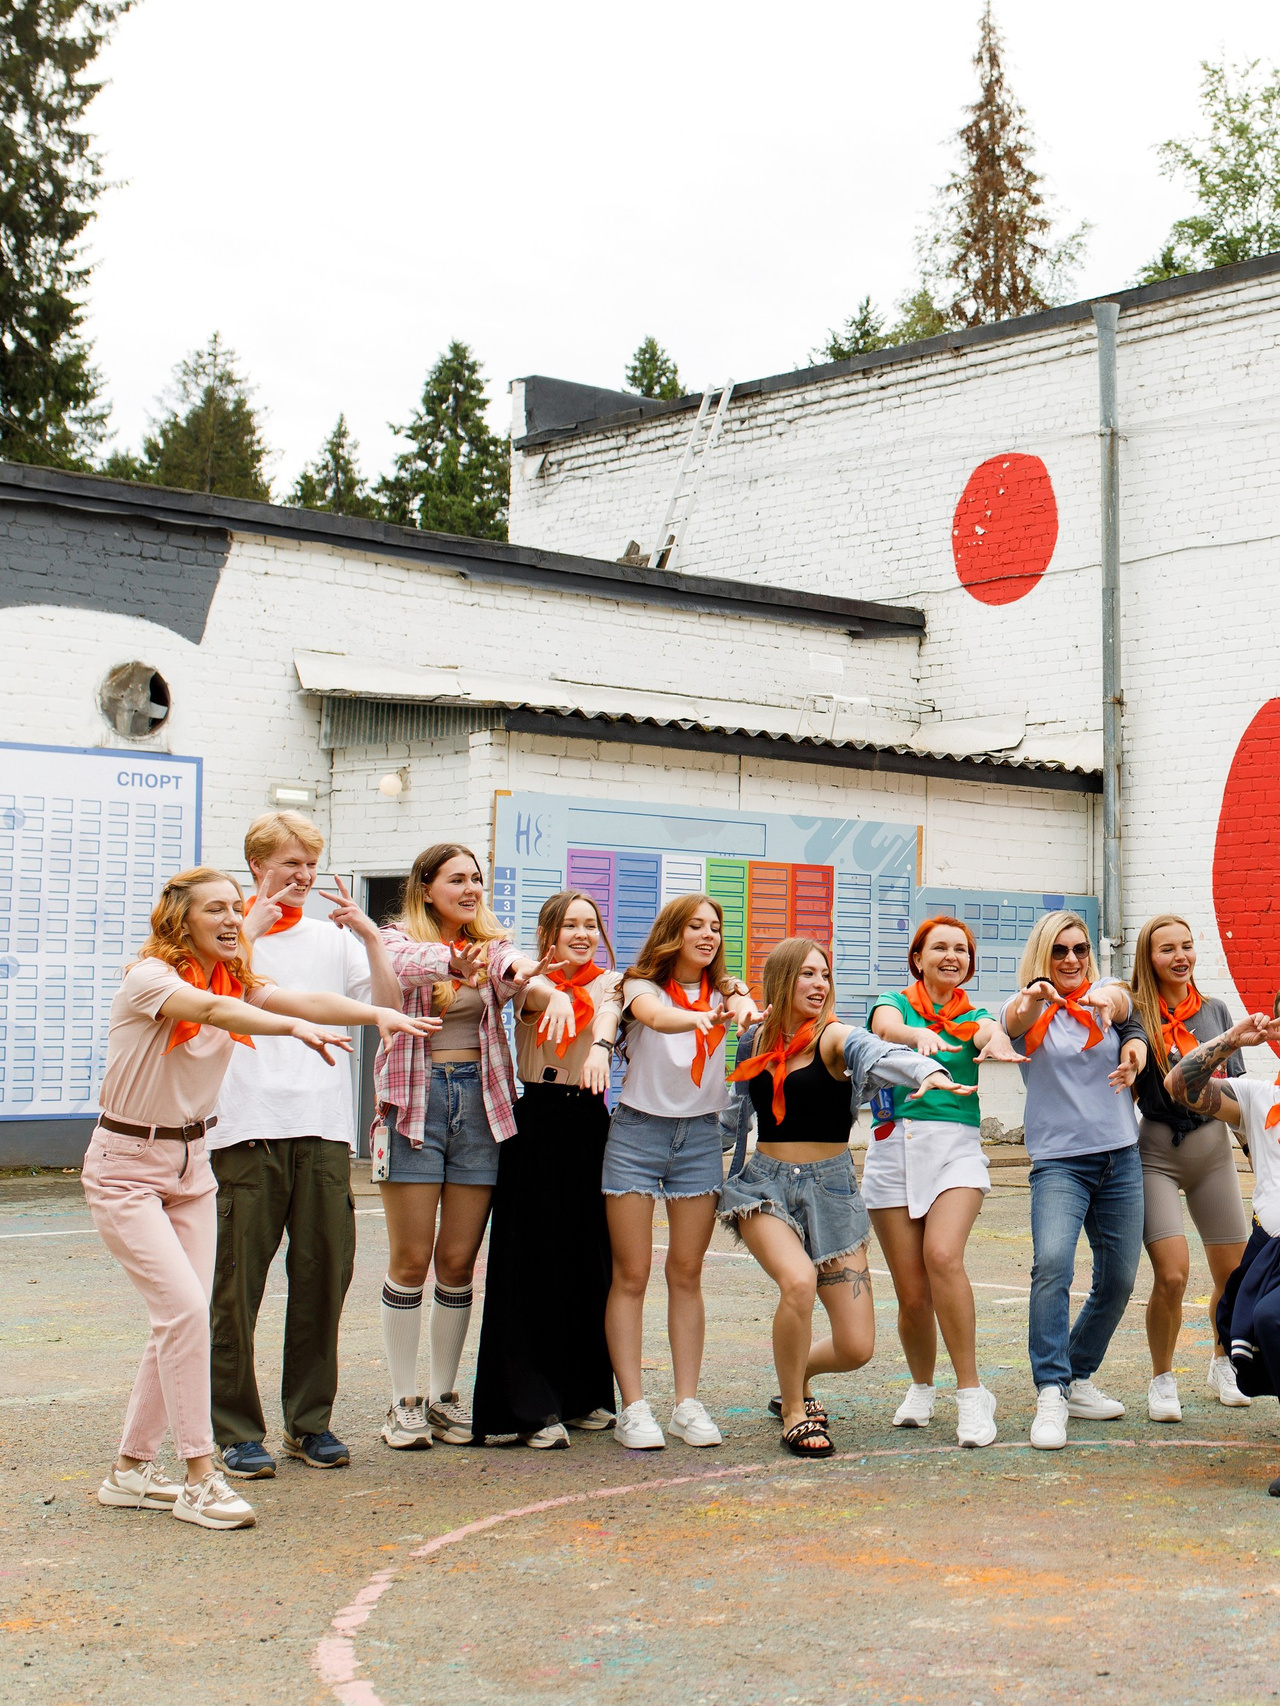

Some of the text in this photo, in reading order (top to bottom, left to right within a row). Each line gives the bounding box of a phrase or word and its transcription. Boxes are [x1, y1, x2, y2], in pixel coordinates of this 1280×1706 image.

[116, 771, 183, 790] СПОРТ
[505, 869, 510, 879] 1
[503, 885, 511, 895] 2
[503, 901, 511, 911] 3
[503, 917, 511, 927] 4
